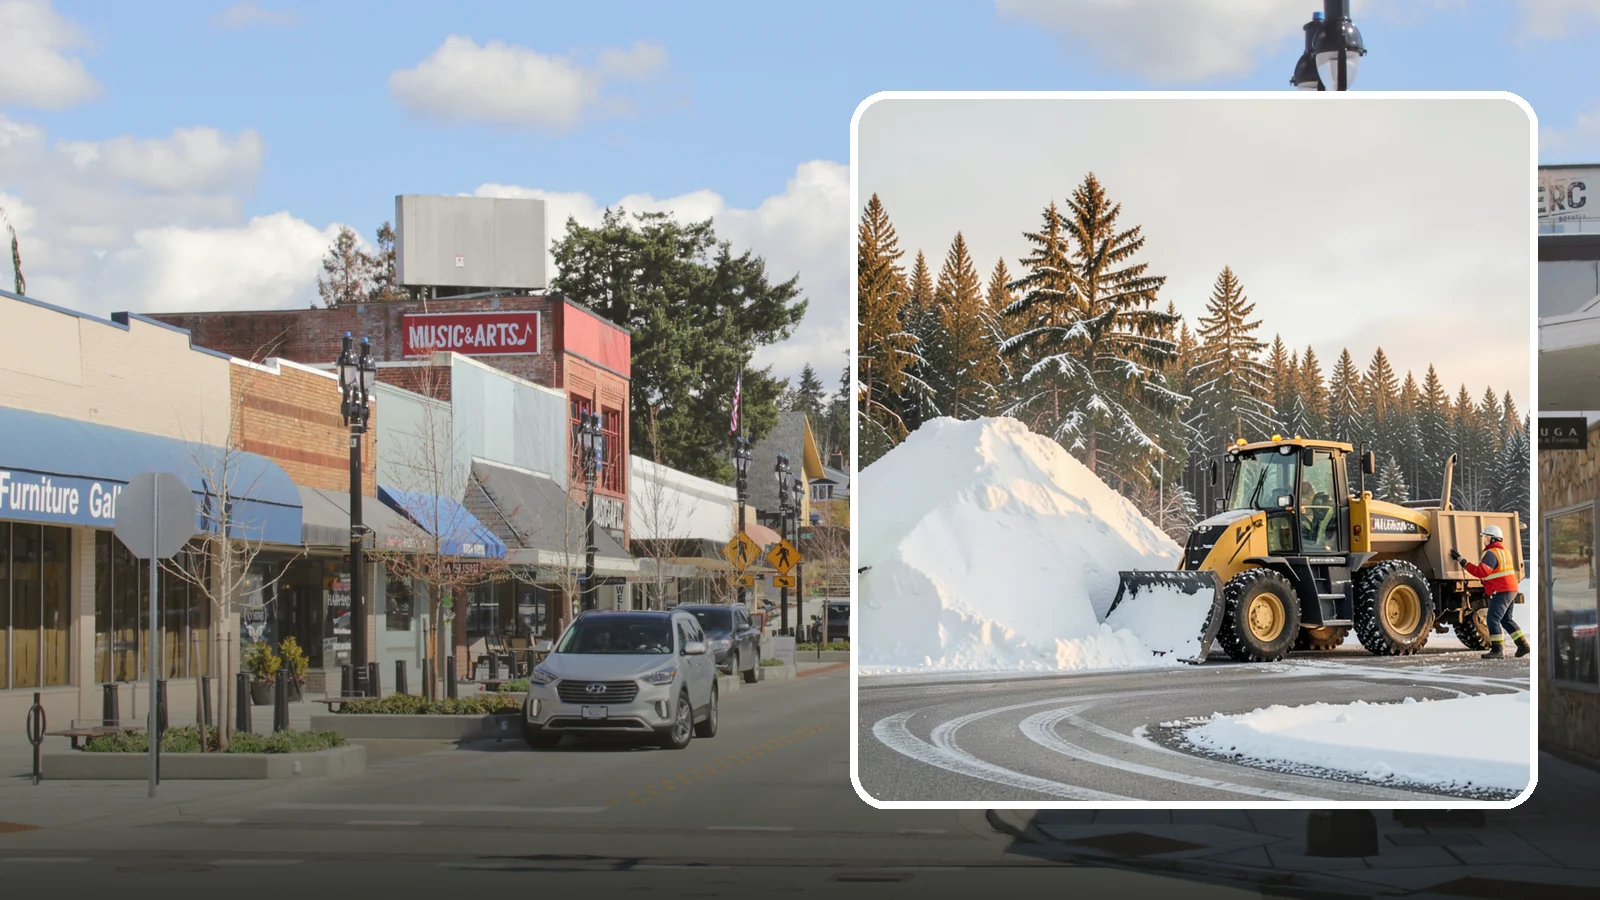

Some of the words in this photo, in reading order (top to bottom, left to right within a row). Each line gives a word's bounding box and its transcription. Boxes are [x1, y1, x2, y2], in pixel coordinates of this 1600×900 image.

[1540, 427, 1577, 436] UGA
[0, 471, 80, 515] Furniture
[453, 563, 479, 574] SUSHI
